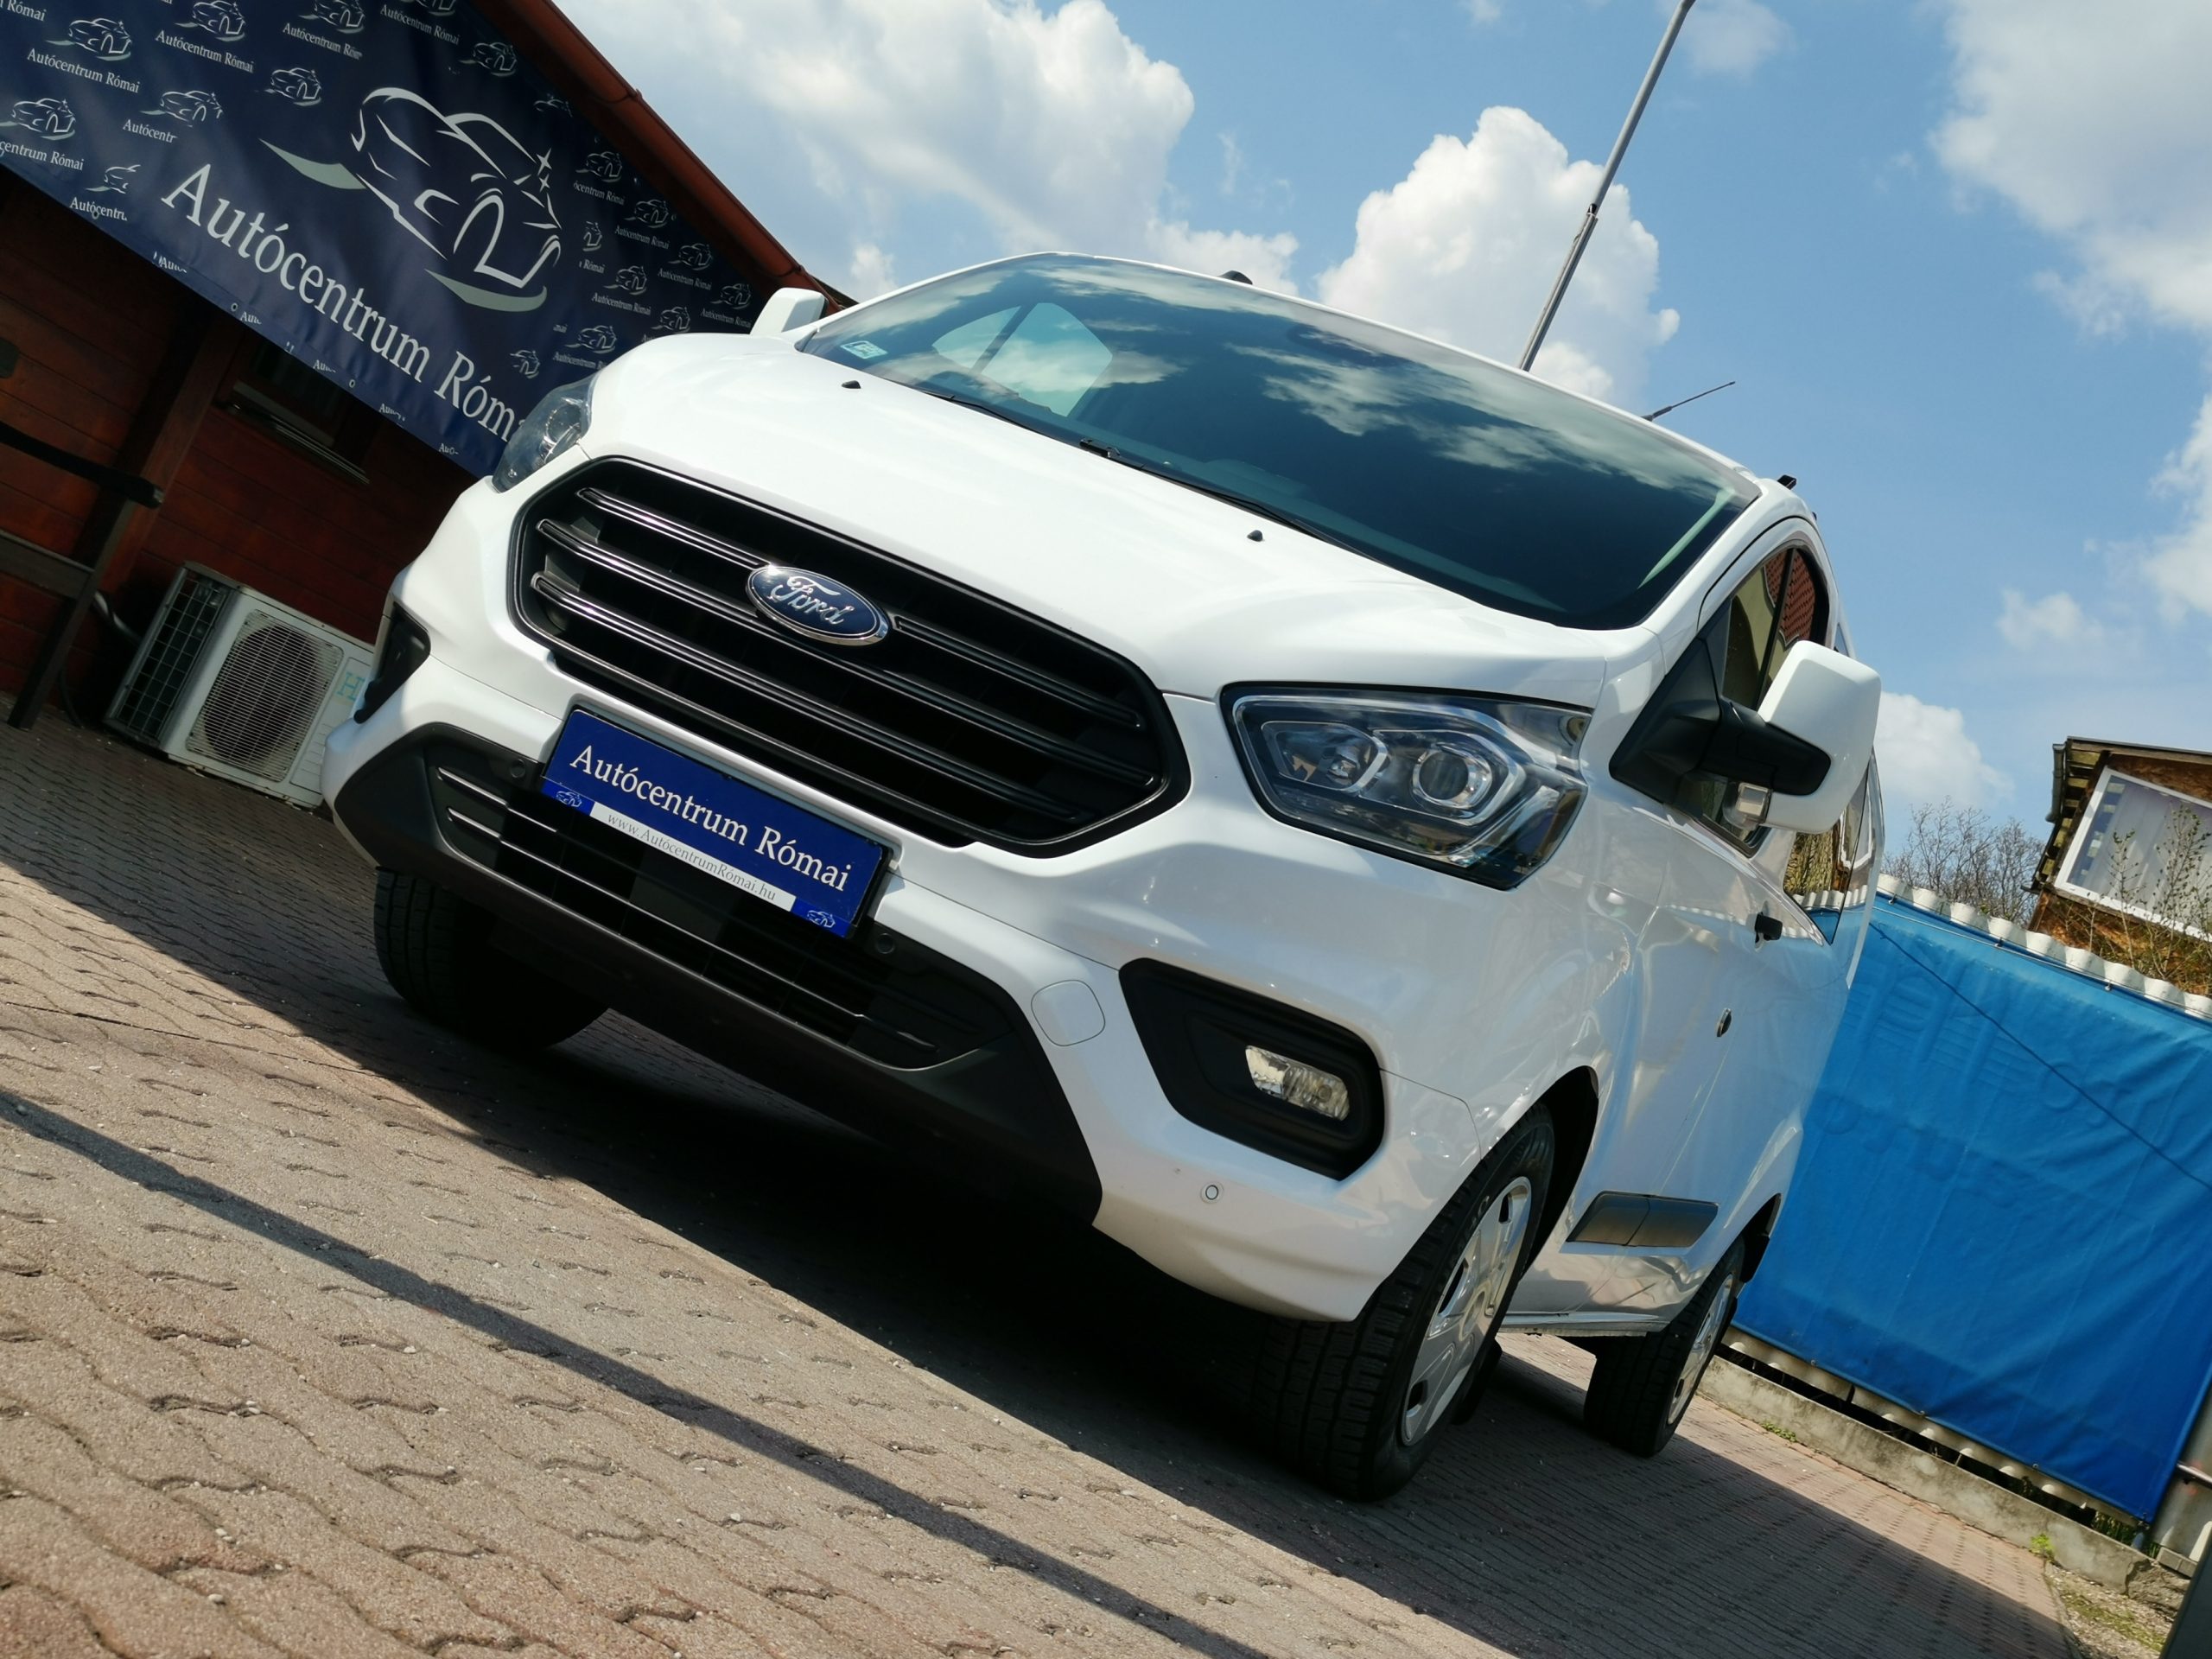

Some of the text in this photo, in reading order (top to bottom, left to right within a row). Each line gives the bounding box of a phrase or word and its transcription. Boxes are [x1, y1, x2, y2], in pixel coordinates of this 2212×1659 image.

[27, 48, 141, 93] Autócentrum Római
[155, 29, 255, 73] Autócentrum Római
[50, 150, 85, 171] Római
[160, 163, 431, 383] Autócentrum
[766, 575, 855, 626] Ford
[569, 745, 853, 892] Autócentrum Római
[607, 813, 777, 902] www.AutócentrumRómai.hu
